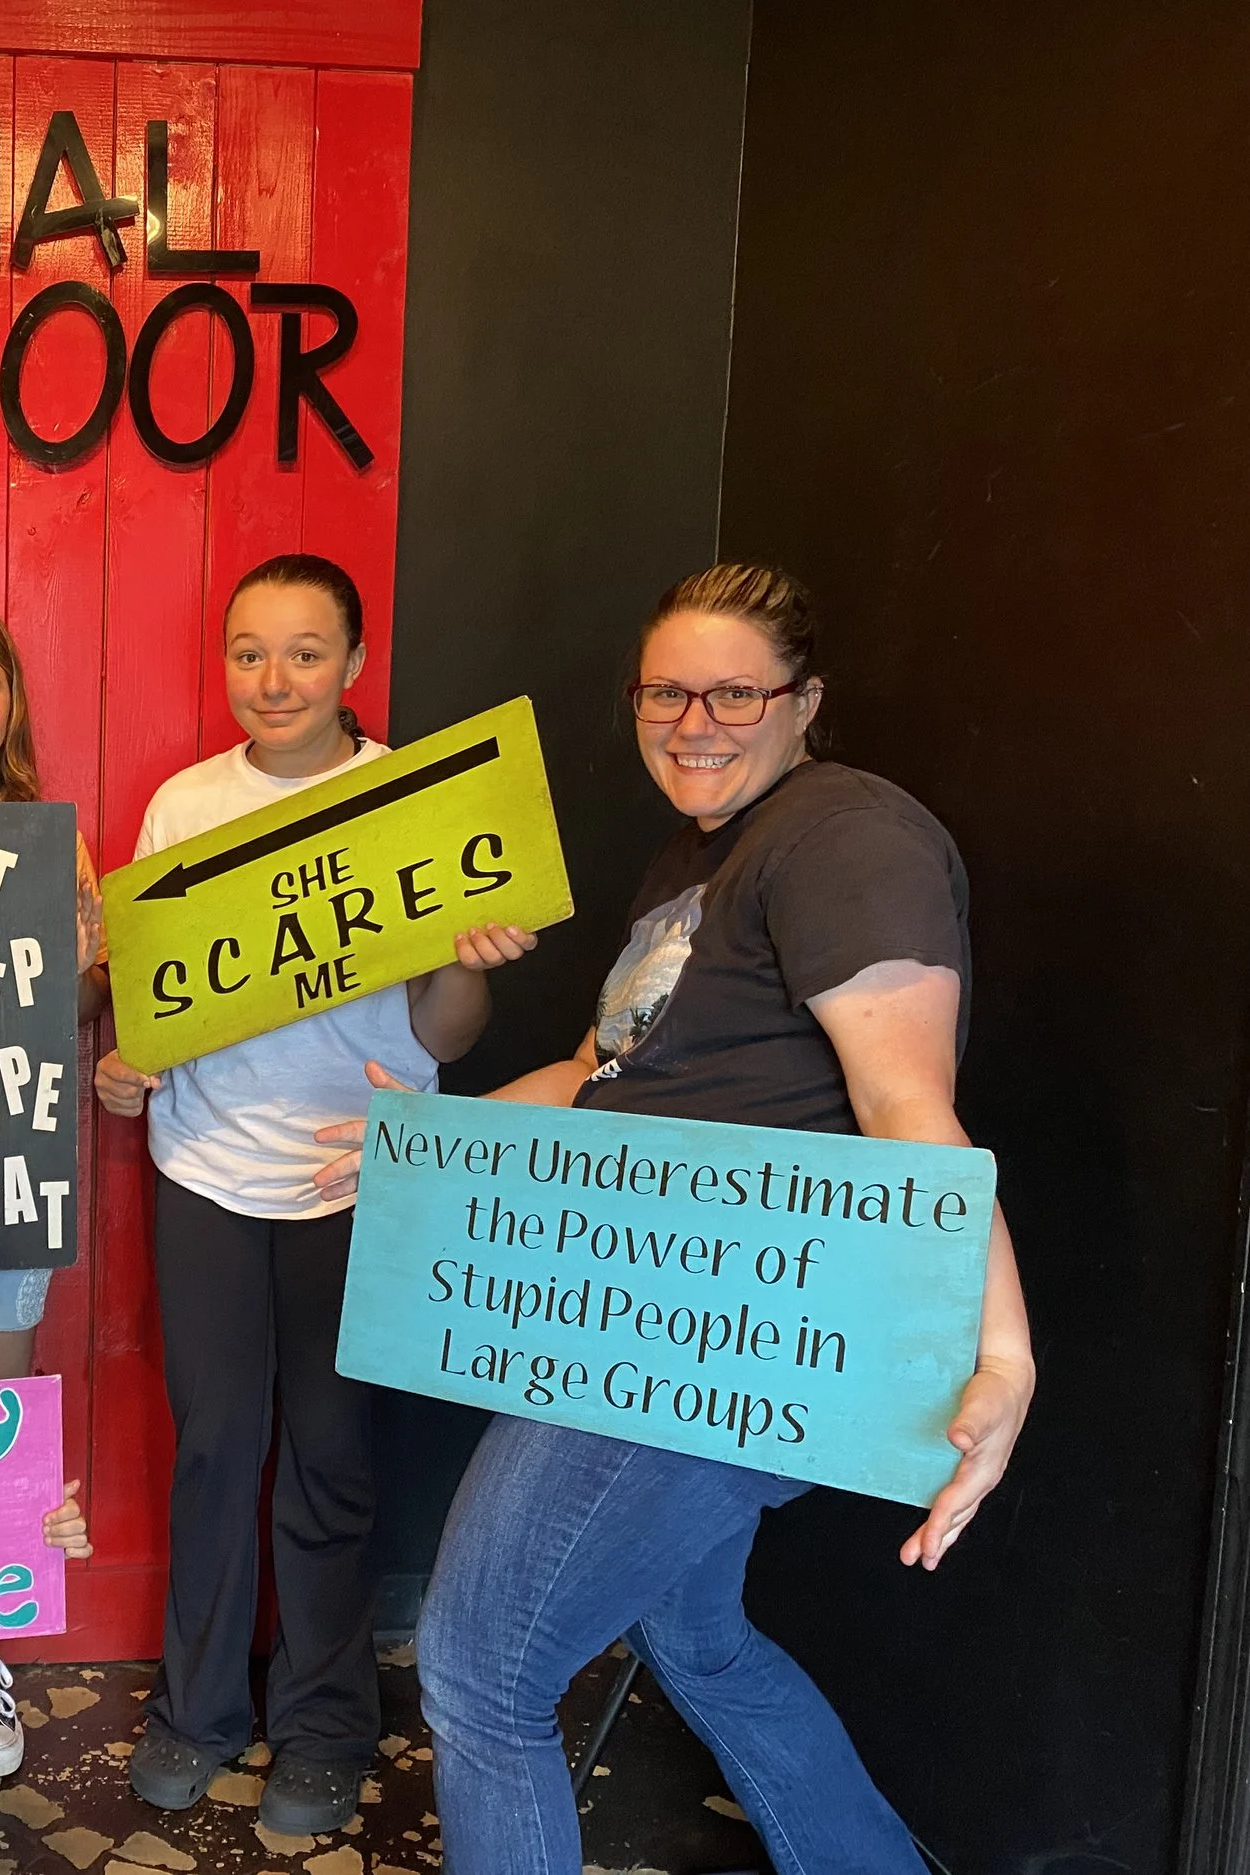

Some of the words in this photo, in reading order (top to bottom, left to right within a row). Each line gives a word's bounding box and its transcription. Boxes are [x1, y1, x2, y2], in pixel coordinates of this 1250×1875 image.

[152, 832, 513, 1021] SCARES
[269, 846, 355, 910] SHE
[293, 953, 363, 1009] ME
[374, 1121, 516, 1177] Never
[527, 1138, 969, 1234] Underestimate
[464, 1196, 546, 1250] the
[556, 1210, 741, 1278] Power
[754, 1237, 827, 1290] of
[428, 1258, 592, 1329] Stupid
[599, 1286, 781, 1364] People
[795, 1315, 848, 1373] in
[440, 1327, 590, 1406] Large
[603, 1361, 810, 1449] Groups
